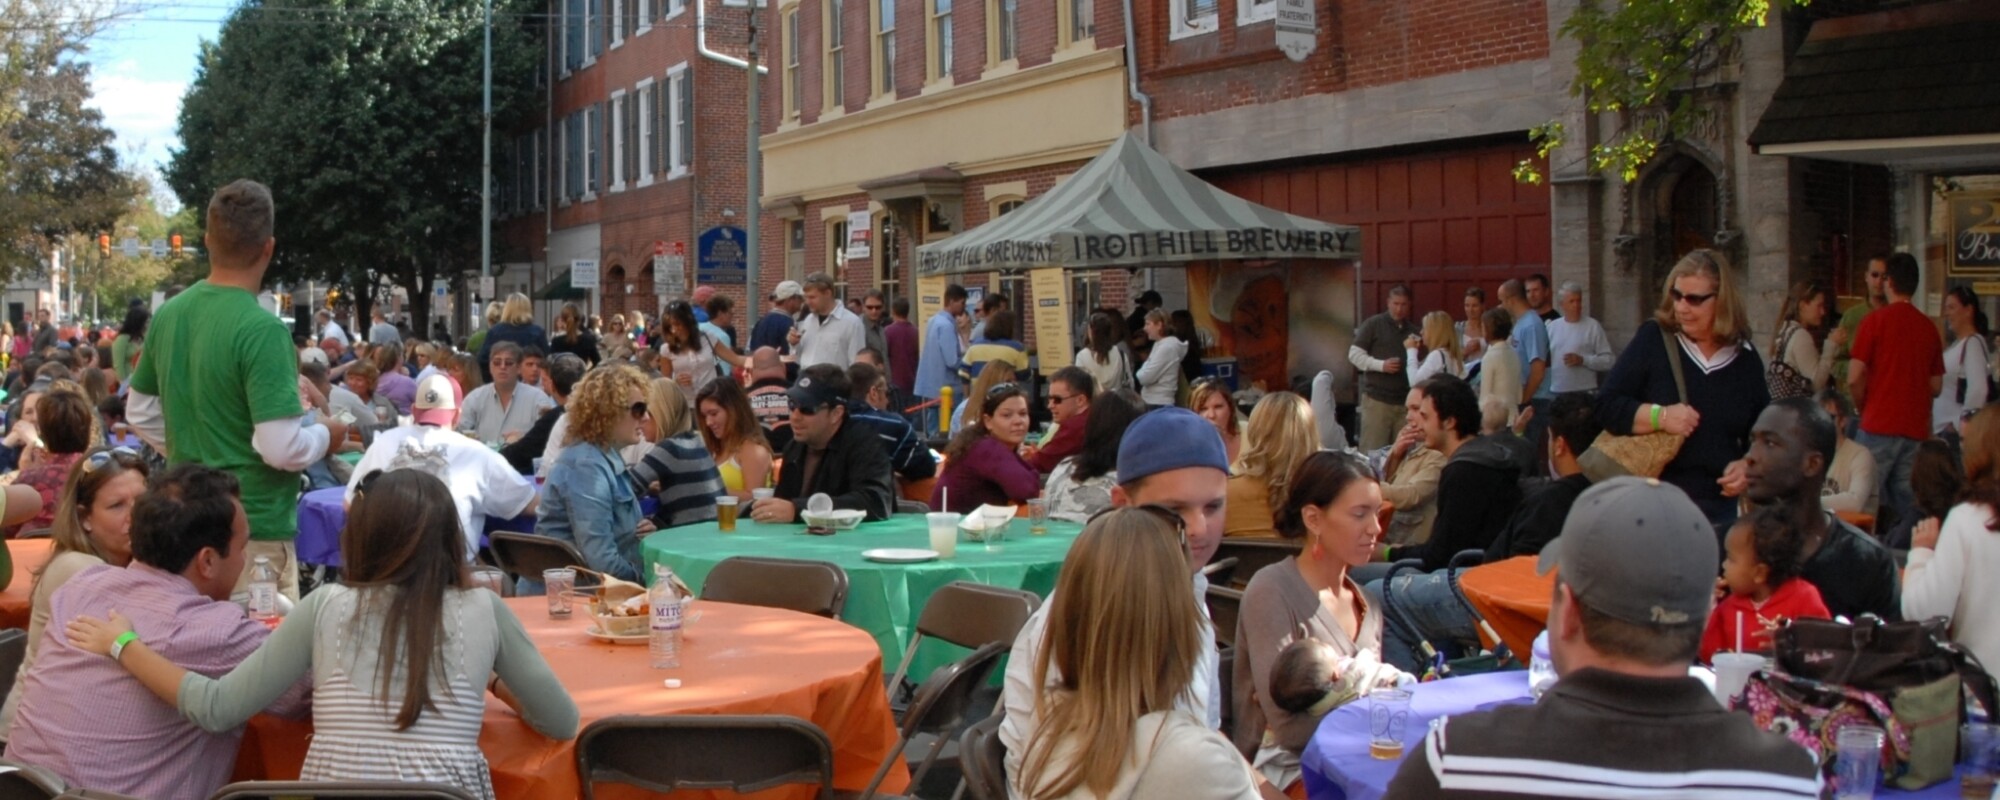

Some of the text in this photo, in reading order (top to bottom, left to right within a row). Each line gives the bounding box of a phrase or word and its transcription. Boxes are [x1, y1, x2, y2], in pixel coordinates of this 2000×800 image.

[1279, 10, 1312, 22] FRATERNITY
[952, 244, 983, 267] HILL
[985, 239, 1053, 263] BREWERY
[1073, 227, 1350, 260] IRON HILL BREWERY
